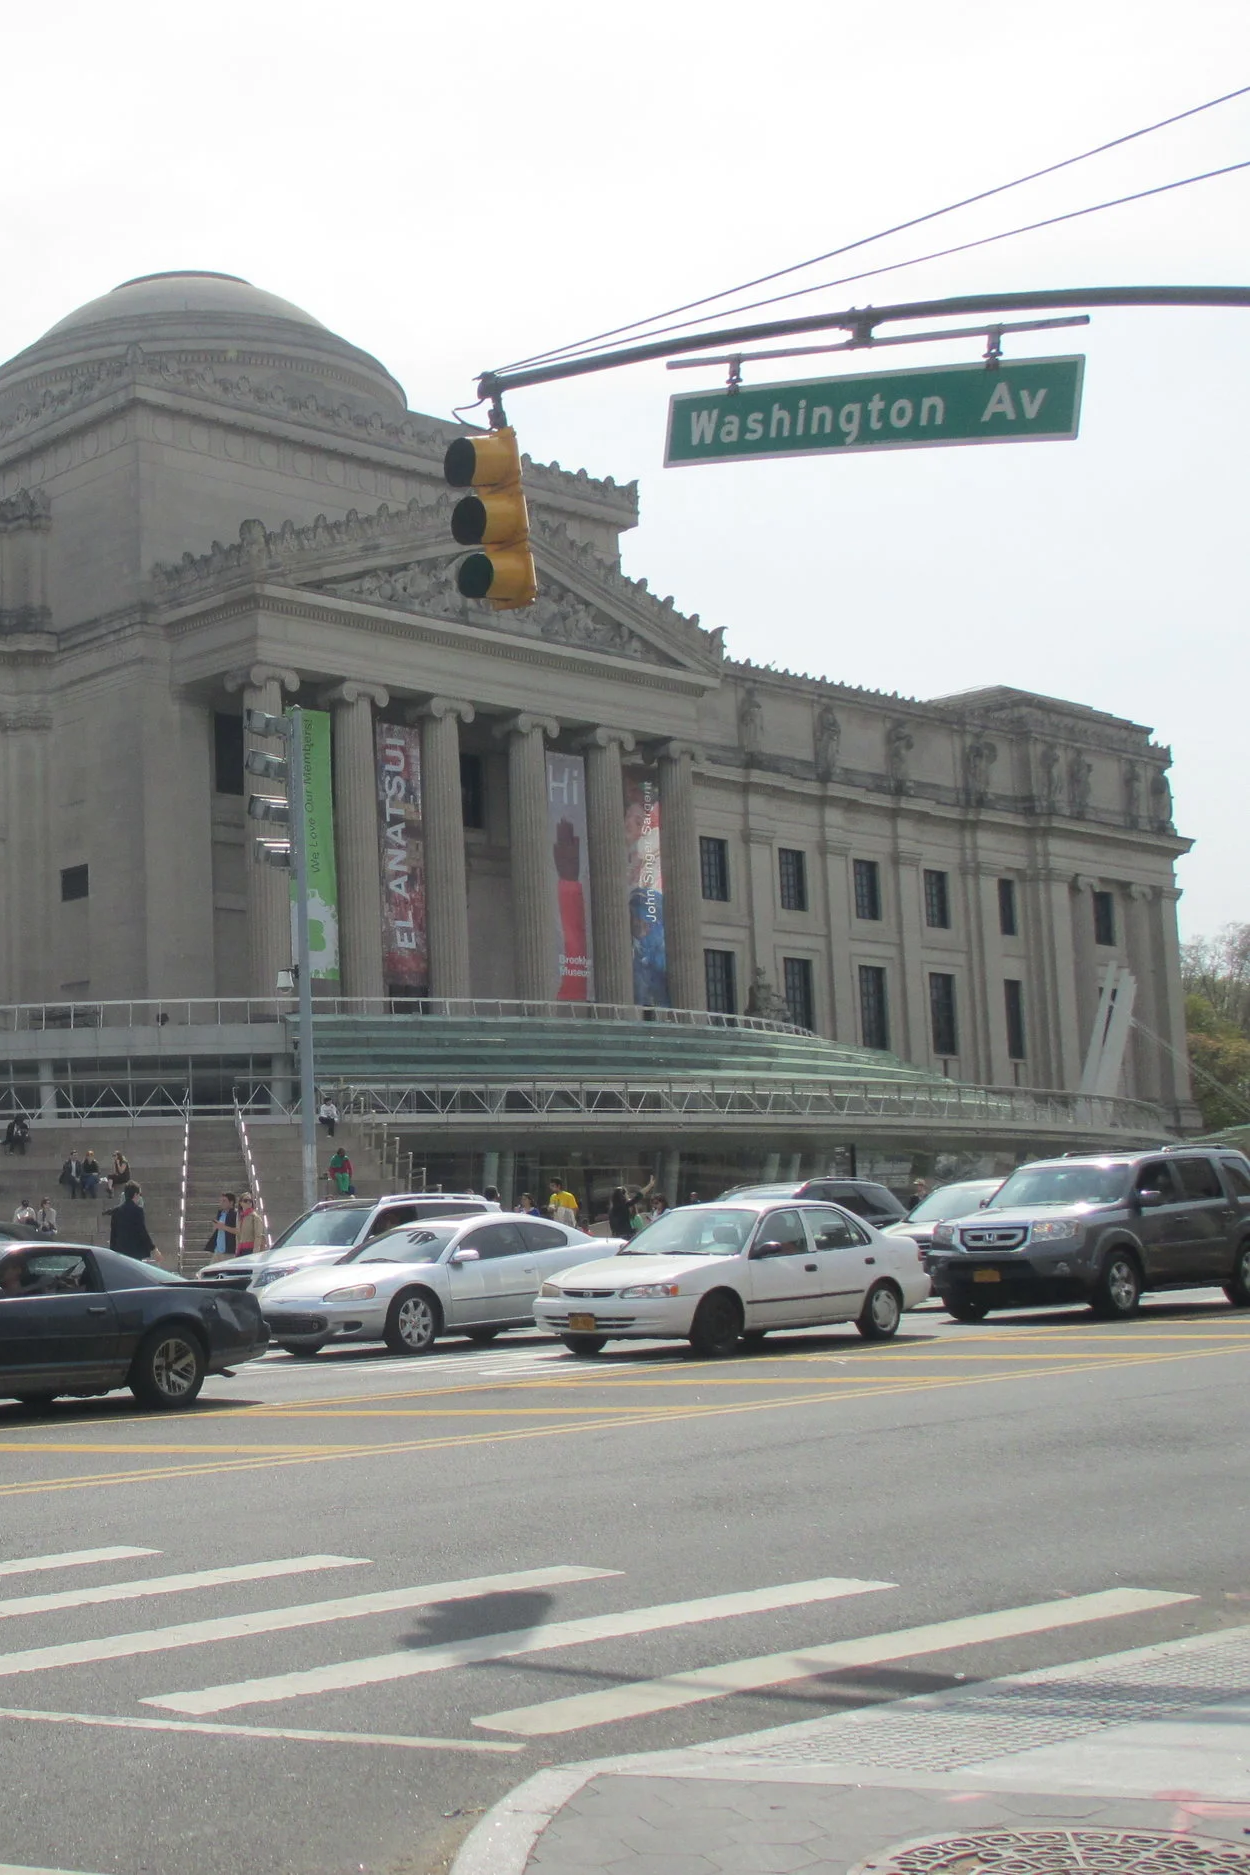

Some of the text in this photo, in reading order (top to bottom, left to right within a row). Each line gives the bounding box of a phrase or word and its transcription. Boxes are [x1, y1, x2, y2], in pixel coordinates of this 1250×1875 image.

[690, 382, 1048, 446] Washington Av
[302, 719, 320, 873] We Love Our Members!
[385, 737, 417, 950] EL ANATSUI
[549, 765, 578, 805] Hi
[641, 781, 657, 922] John Singer Sargent
